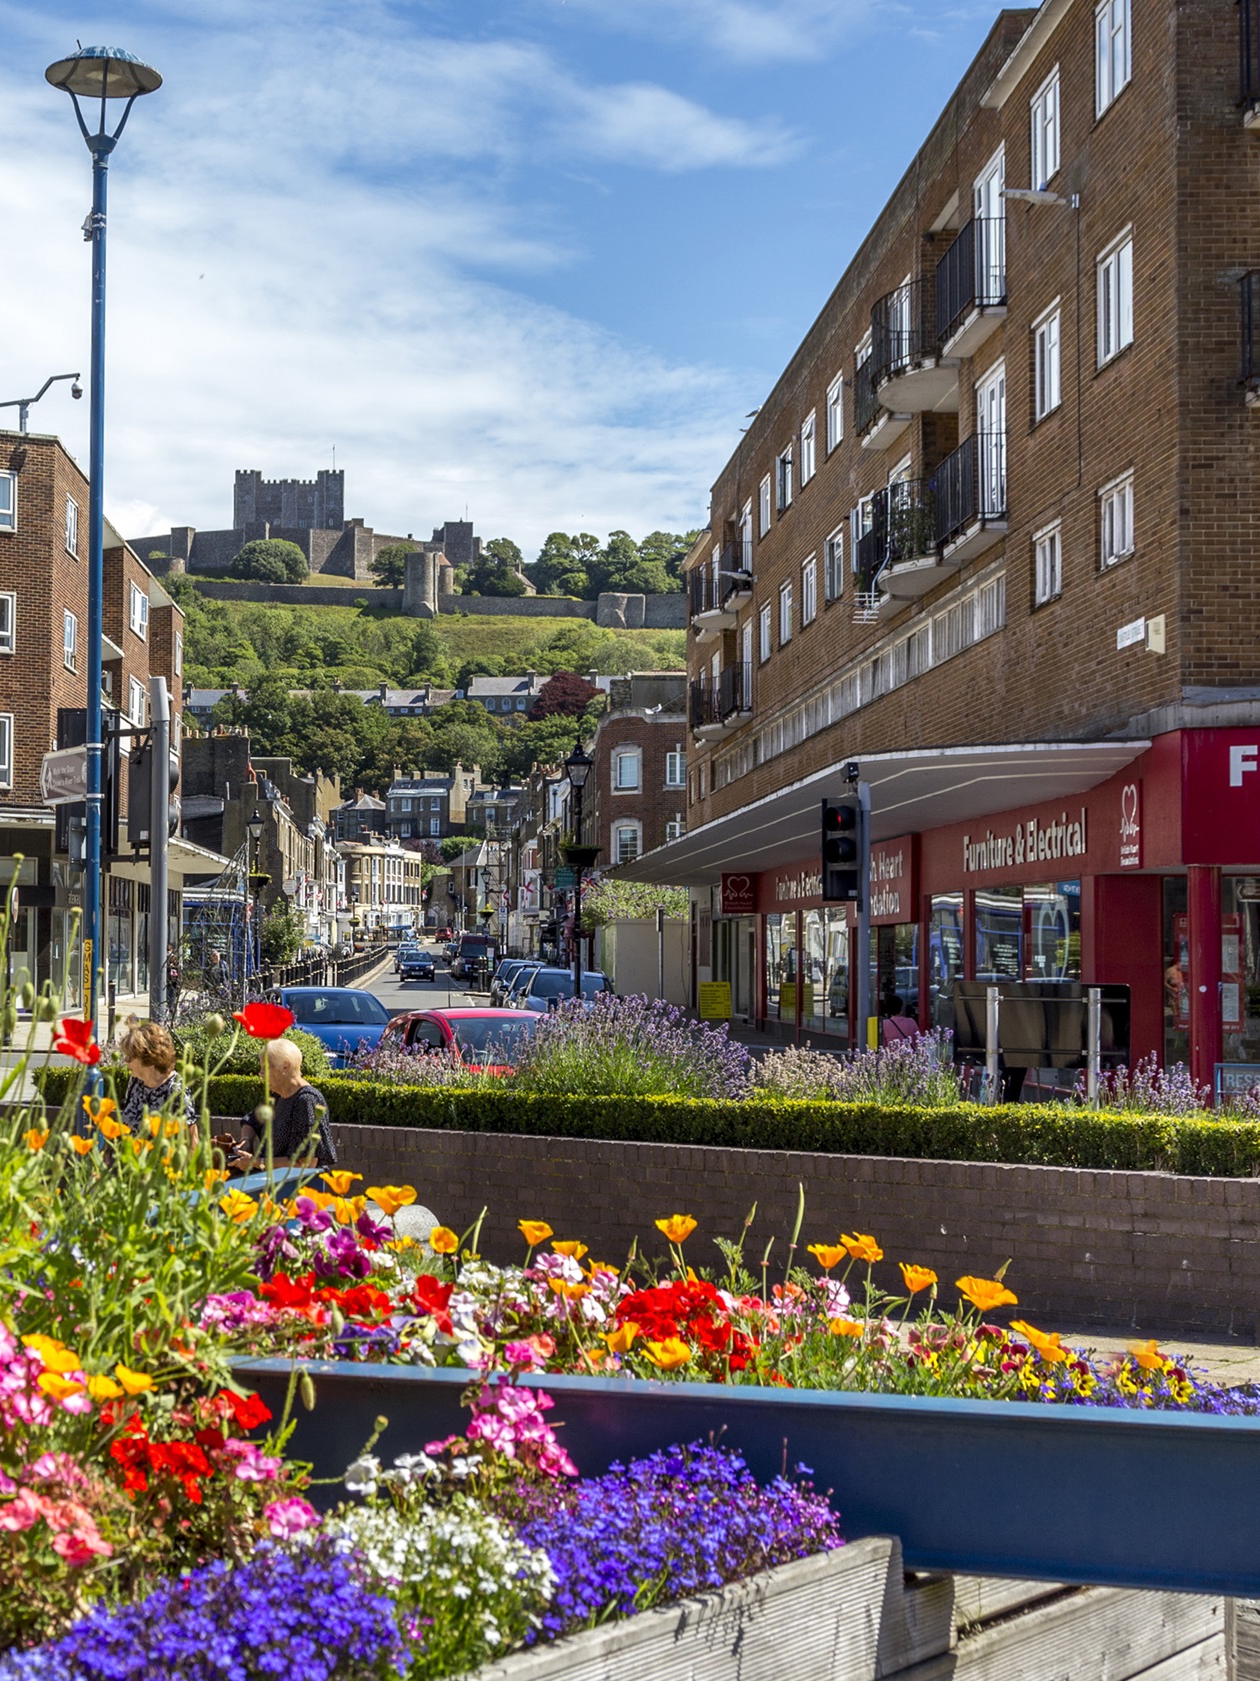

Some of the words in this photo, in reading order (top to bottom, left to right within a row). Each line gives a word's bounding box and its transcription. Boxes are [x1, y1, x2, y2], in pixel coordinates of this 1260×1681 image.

[963, 829, 1013, 873] Furniture
[1015, 824, 1024, 865] &
[1026, 807, 1086, 862] Electrical
[879, 849, 903, 881] Heart
